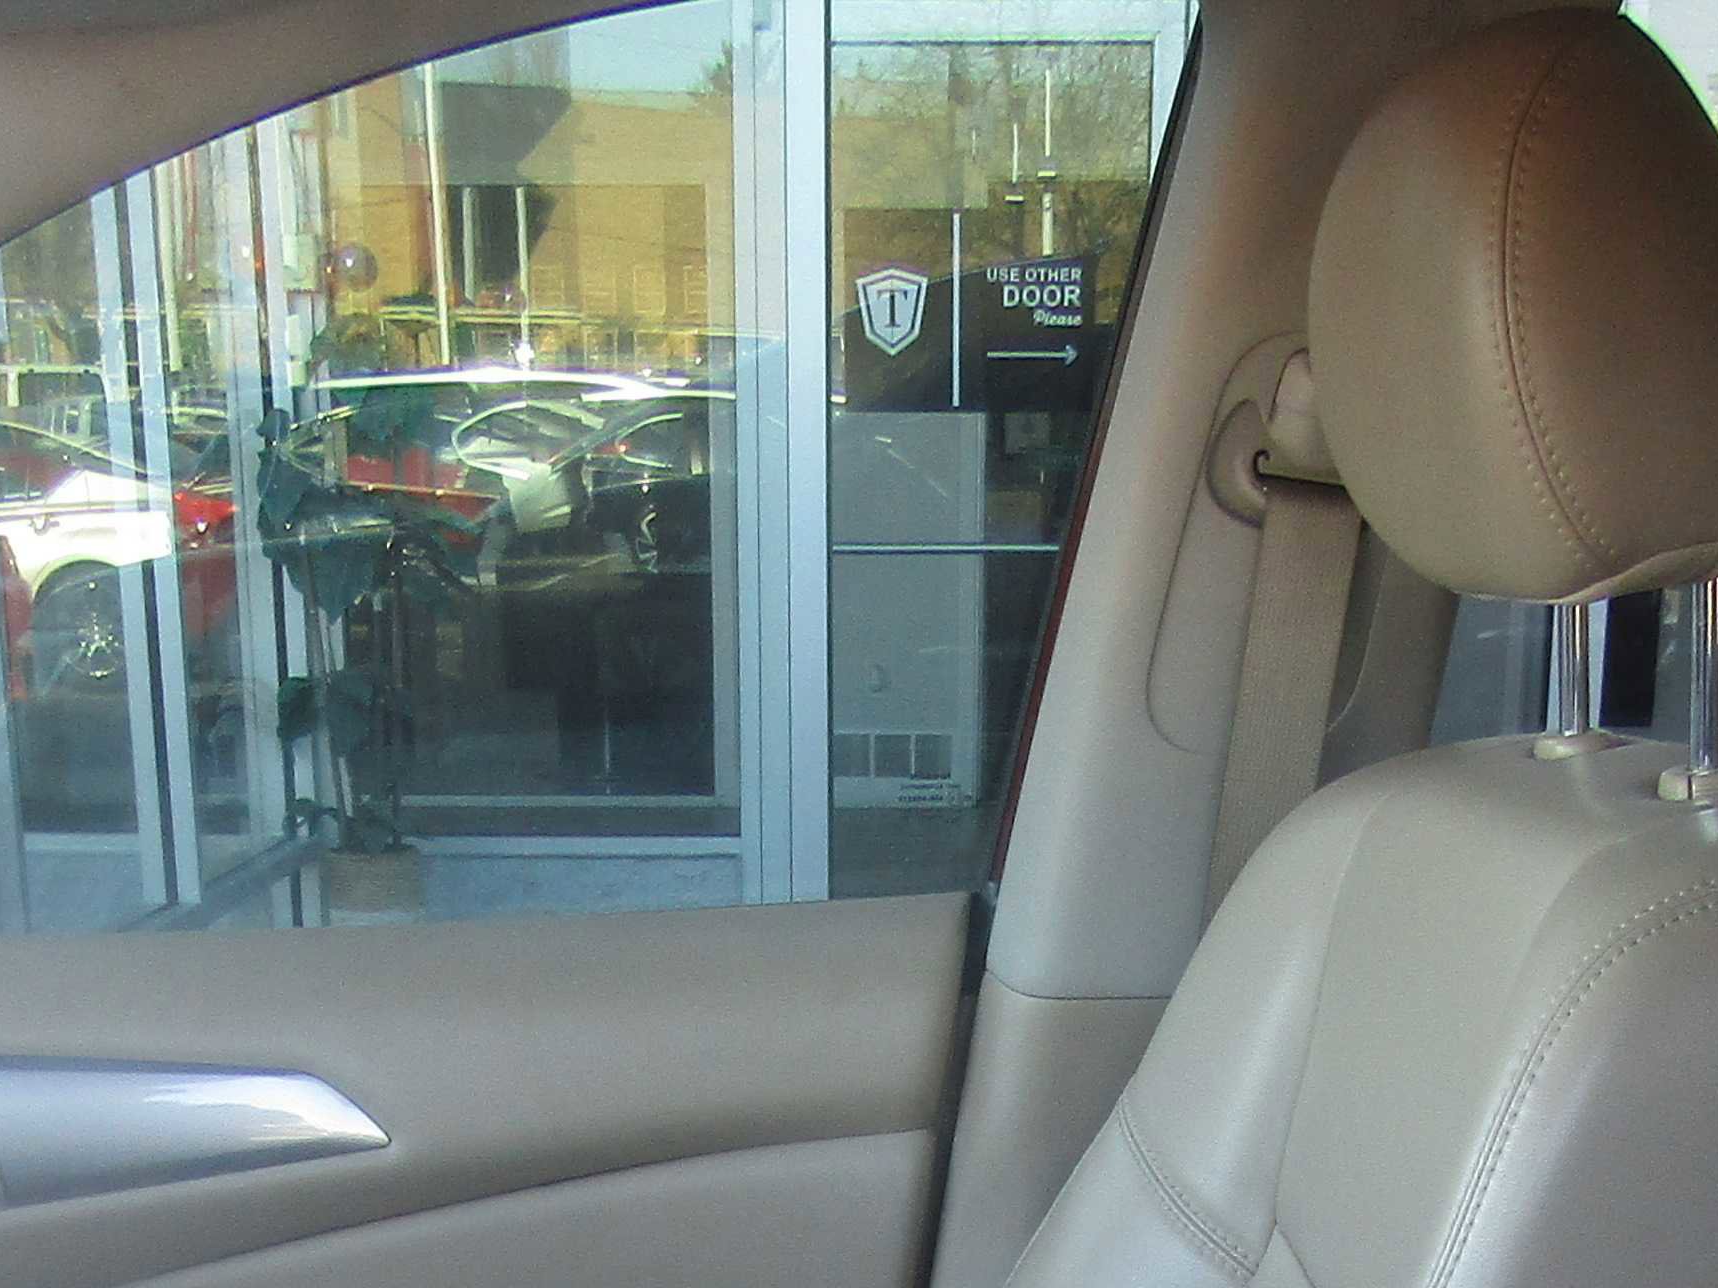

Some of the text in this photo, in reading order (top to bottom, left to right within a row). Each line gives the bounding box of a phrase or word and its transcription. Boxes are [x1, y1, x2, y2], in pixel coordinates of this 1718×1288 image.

[987, 267, 1083, 282] USE OTHER
[1003, 285, 1082, 308] DOOR
[876, 289, 908, 328] T
[1033, 309, 1083, 327] Please
